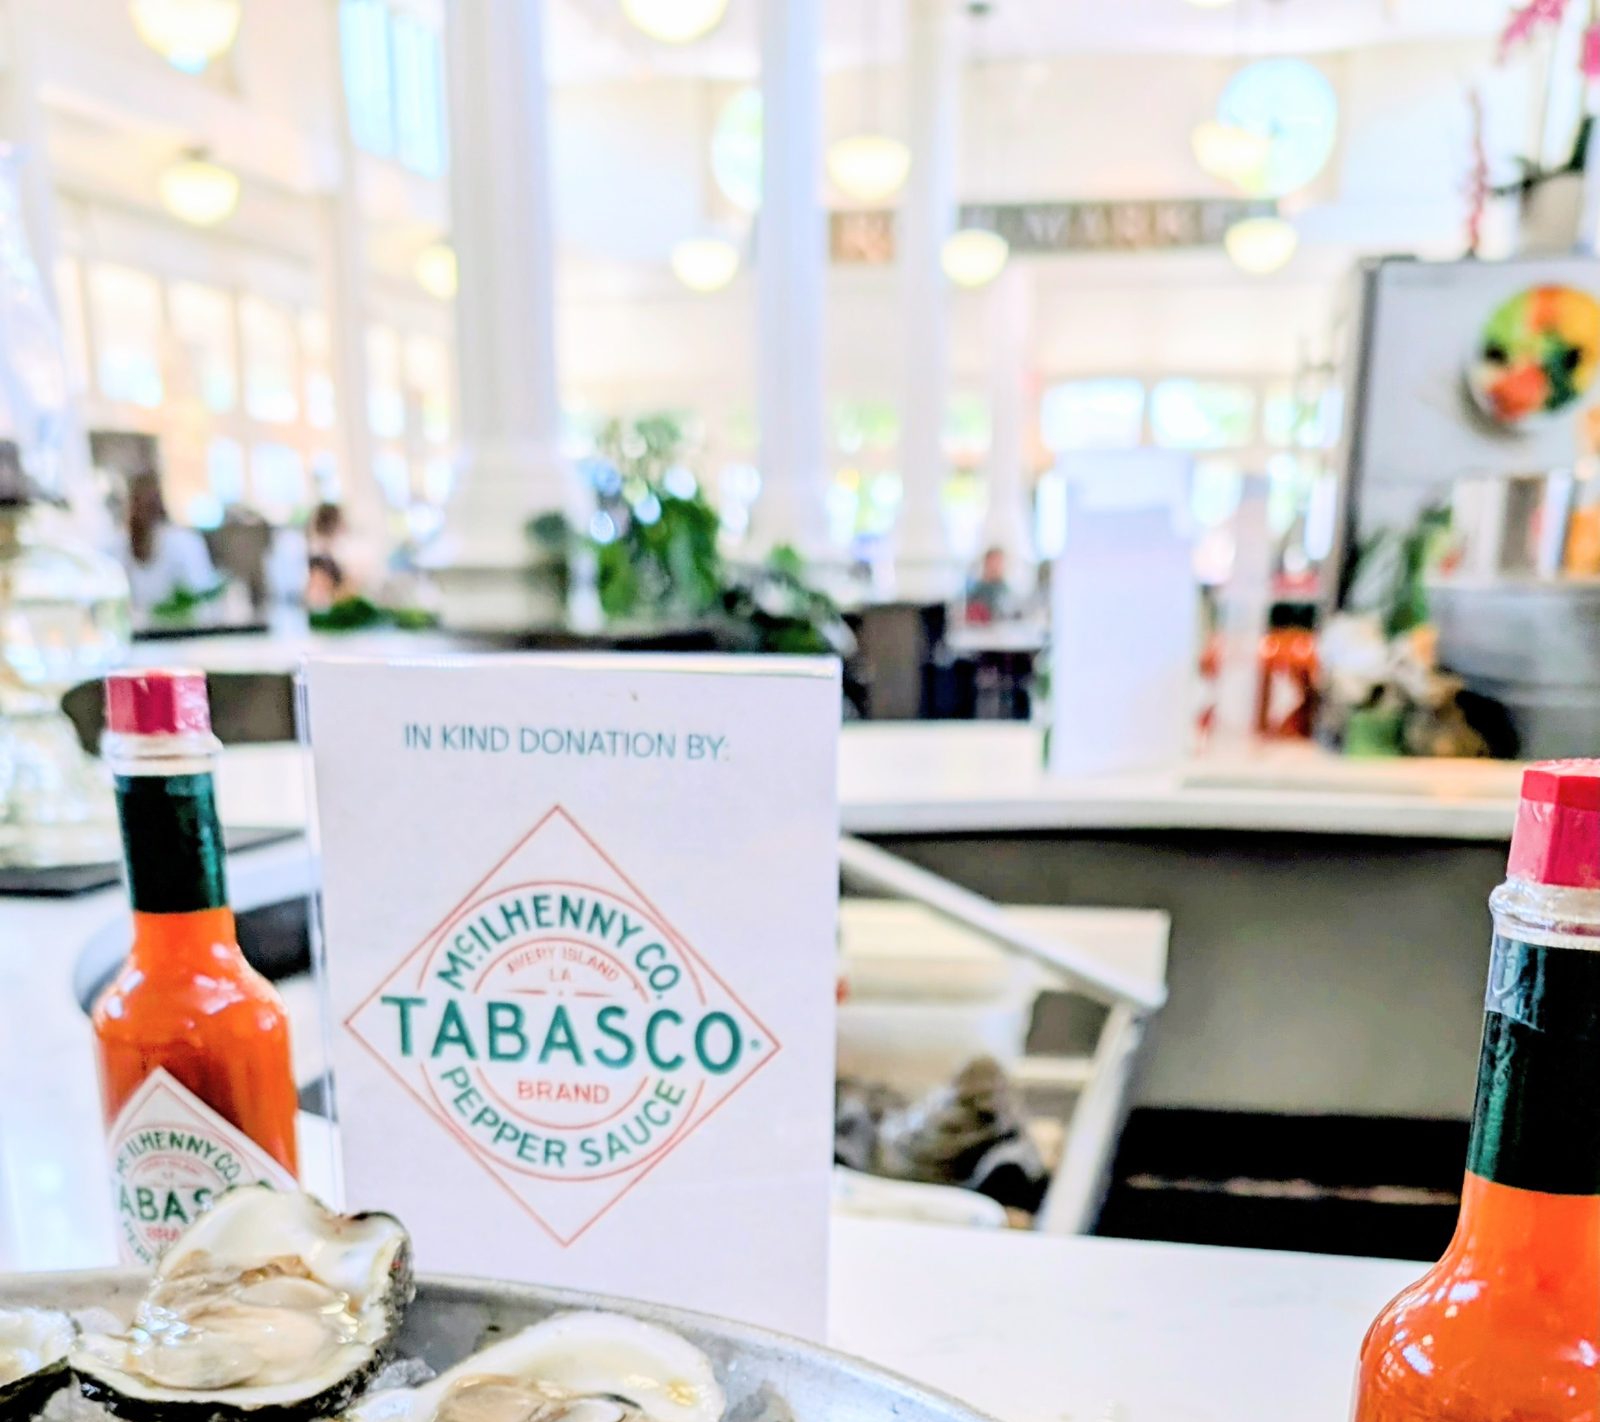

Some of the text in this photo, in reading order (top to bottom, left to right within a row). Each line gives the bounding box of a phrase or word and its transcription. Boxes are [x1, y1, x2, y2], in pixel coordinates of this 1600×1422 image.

[405, 723, 432, 750] IN
[441, 725, 510, 753] KIND
[519, 727, 677, 758] DONATION
[380, 996, 744, 1076] TABASCO
[440, 1065, 687, 1168] PEPPER SAUCE
[516, 1079, 611, 1105] BRAND
